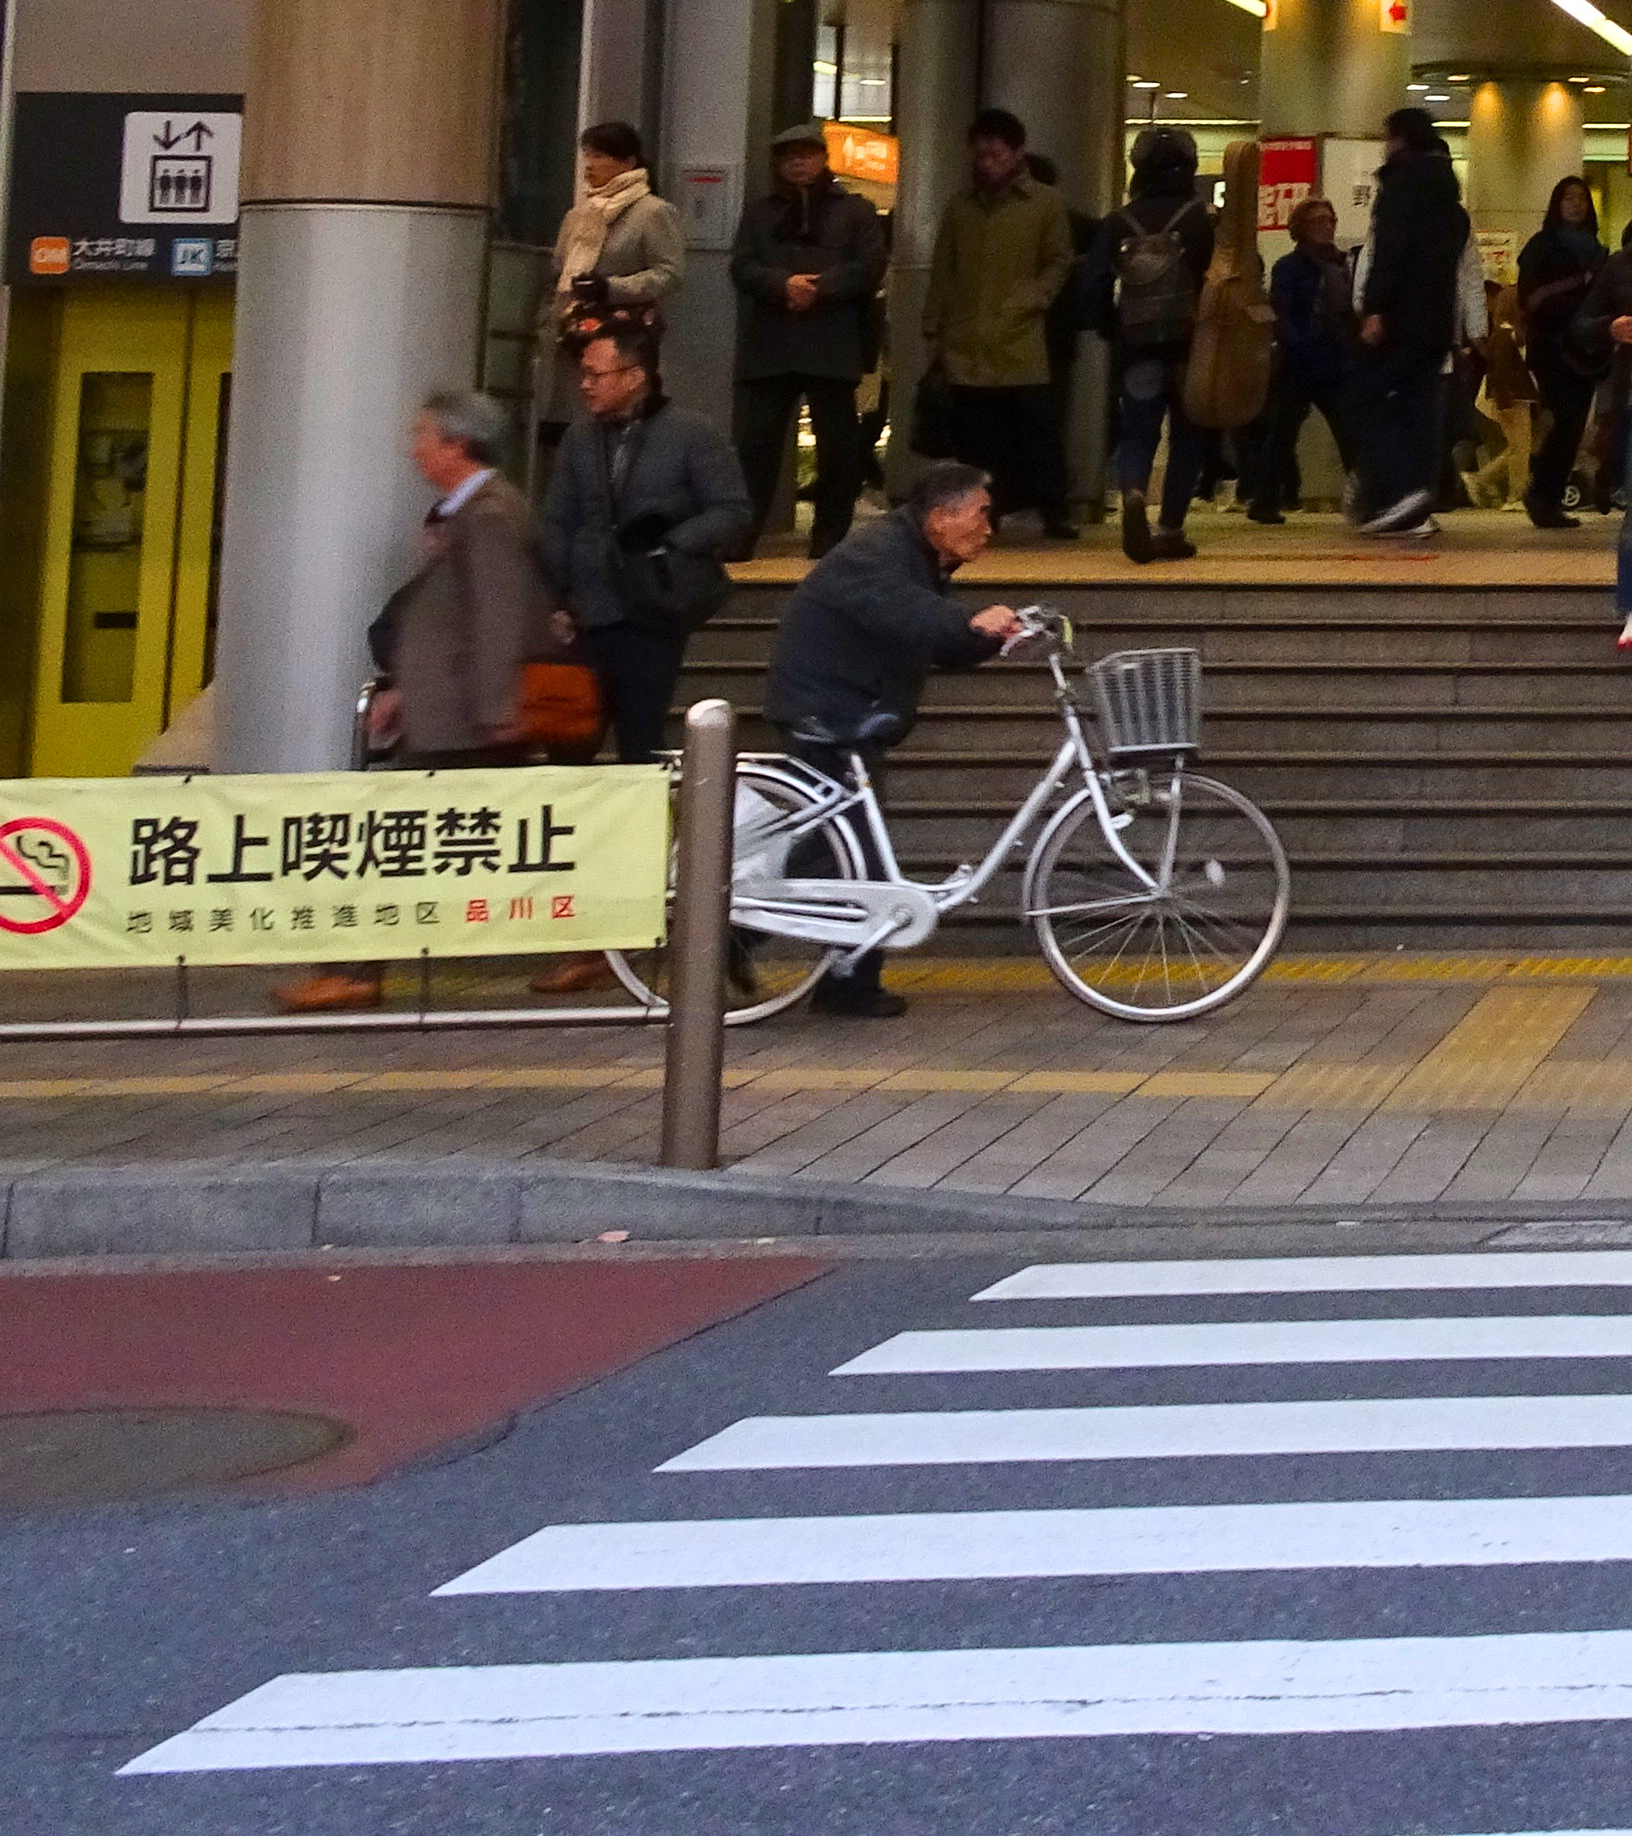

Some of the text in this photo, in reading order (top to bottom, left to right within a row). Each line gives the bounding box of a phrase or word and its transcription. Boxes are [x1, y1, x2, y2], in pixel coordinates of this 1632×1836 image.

[72, 237, 156, 257] 大井町線
[128, 804, 577, 886] 路上喫煙禁止
[125, 894, 576, 934] 地域美化推進地区 品川区
